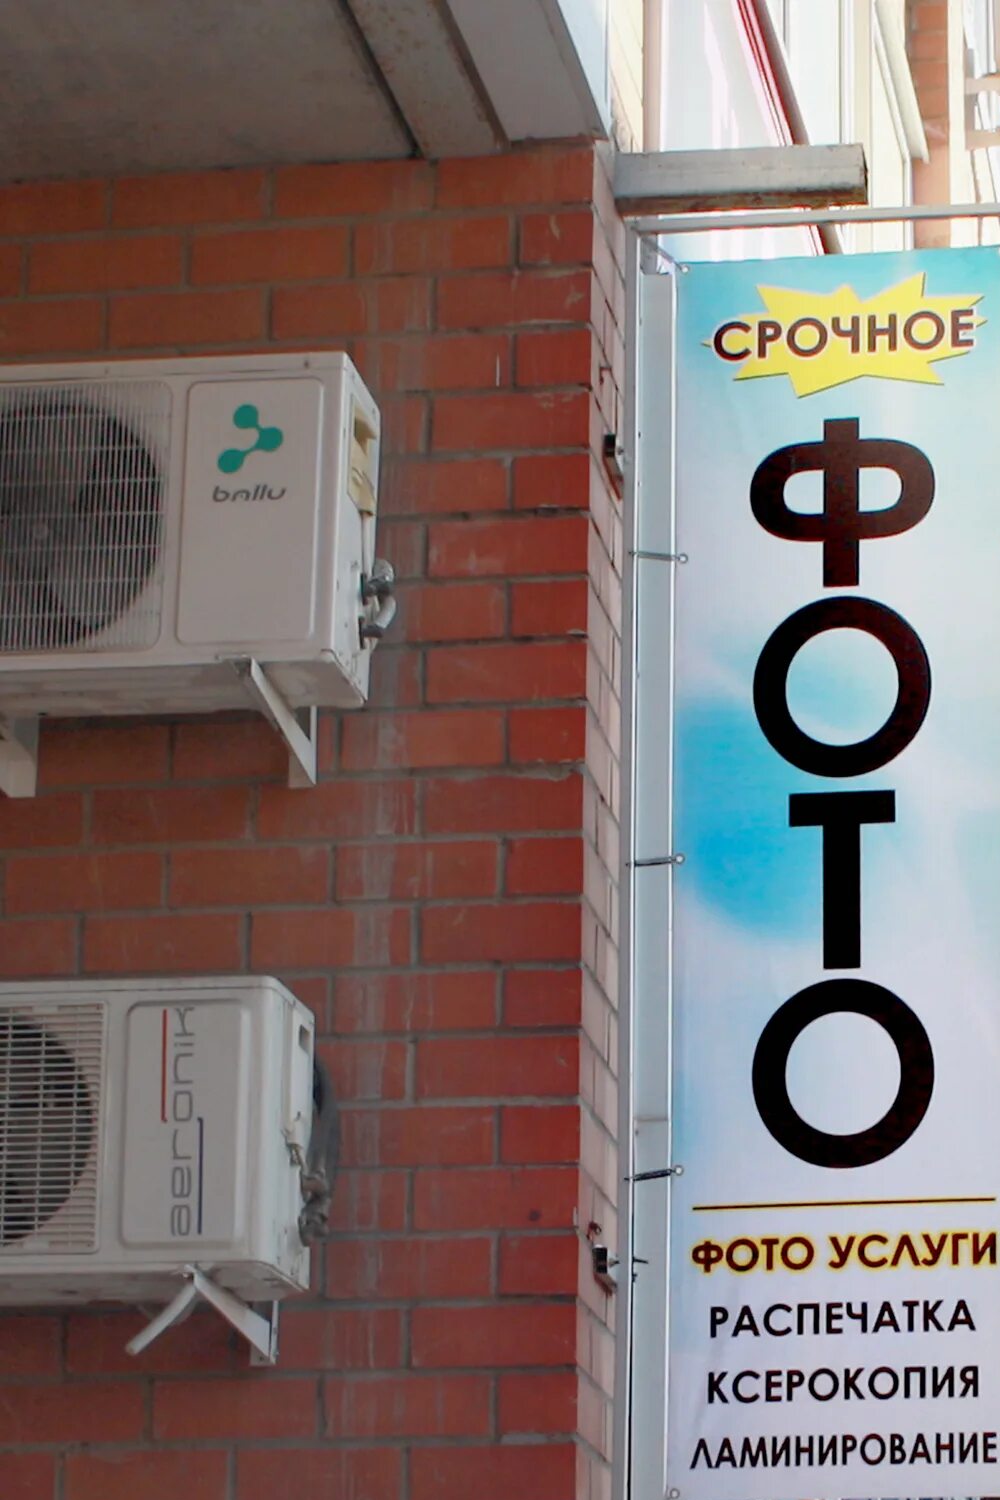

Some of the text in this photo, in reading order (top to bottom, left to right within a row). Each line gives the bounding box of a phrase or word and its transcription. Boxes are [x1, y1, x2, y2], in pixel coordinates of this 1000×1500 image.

[713, 307, 978, 361] СРОЧНОЕ
[212, 483, 286, 504] ballu
[750, 417, 936, 1167] ФОТО
[170, 1006, 196, 1237] aeronik
[691, 1229, 998, 1272] ФОТО УСЛУГИ
[709, 1299, 977, 1338] РАСПЕЧАТКА
[707, 1365, 980, 1405] КСЕРОКОПИЯ
[690, 1432, 998, 1470] ЛАМИНИРОВАНИЕ
